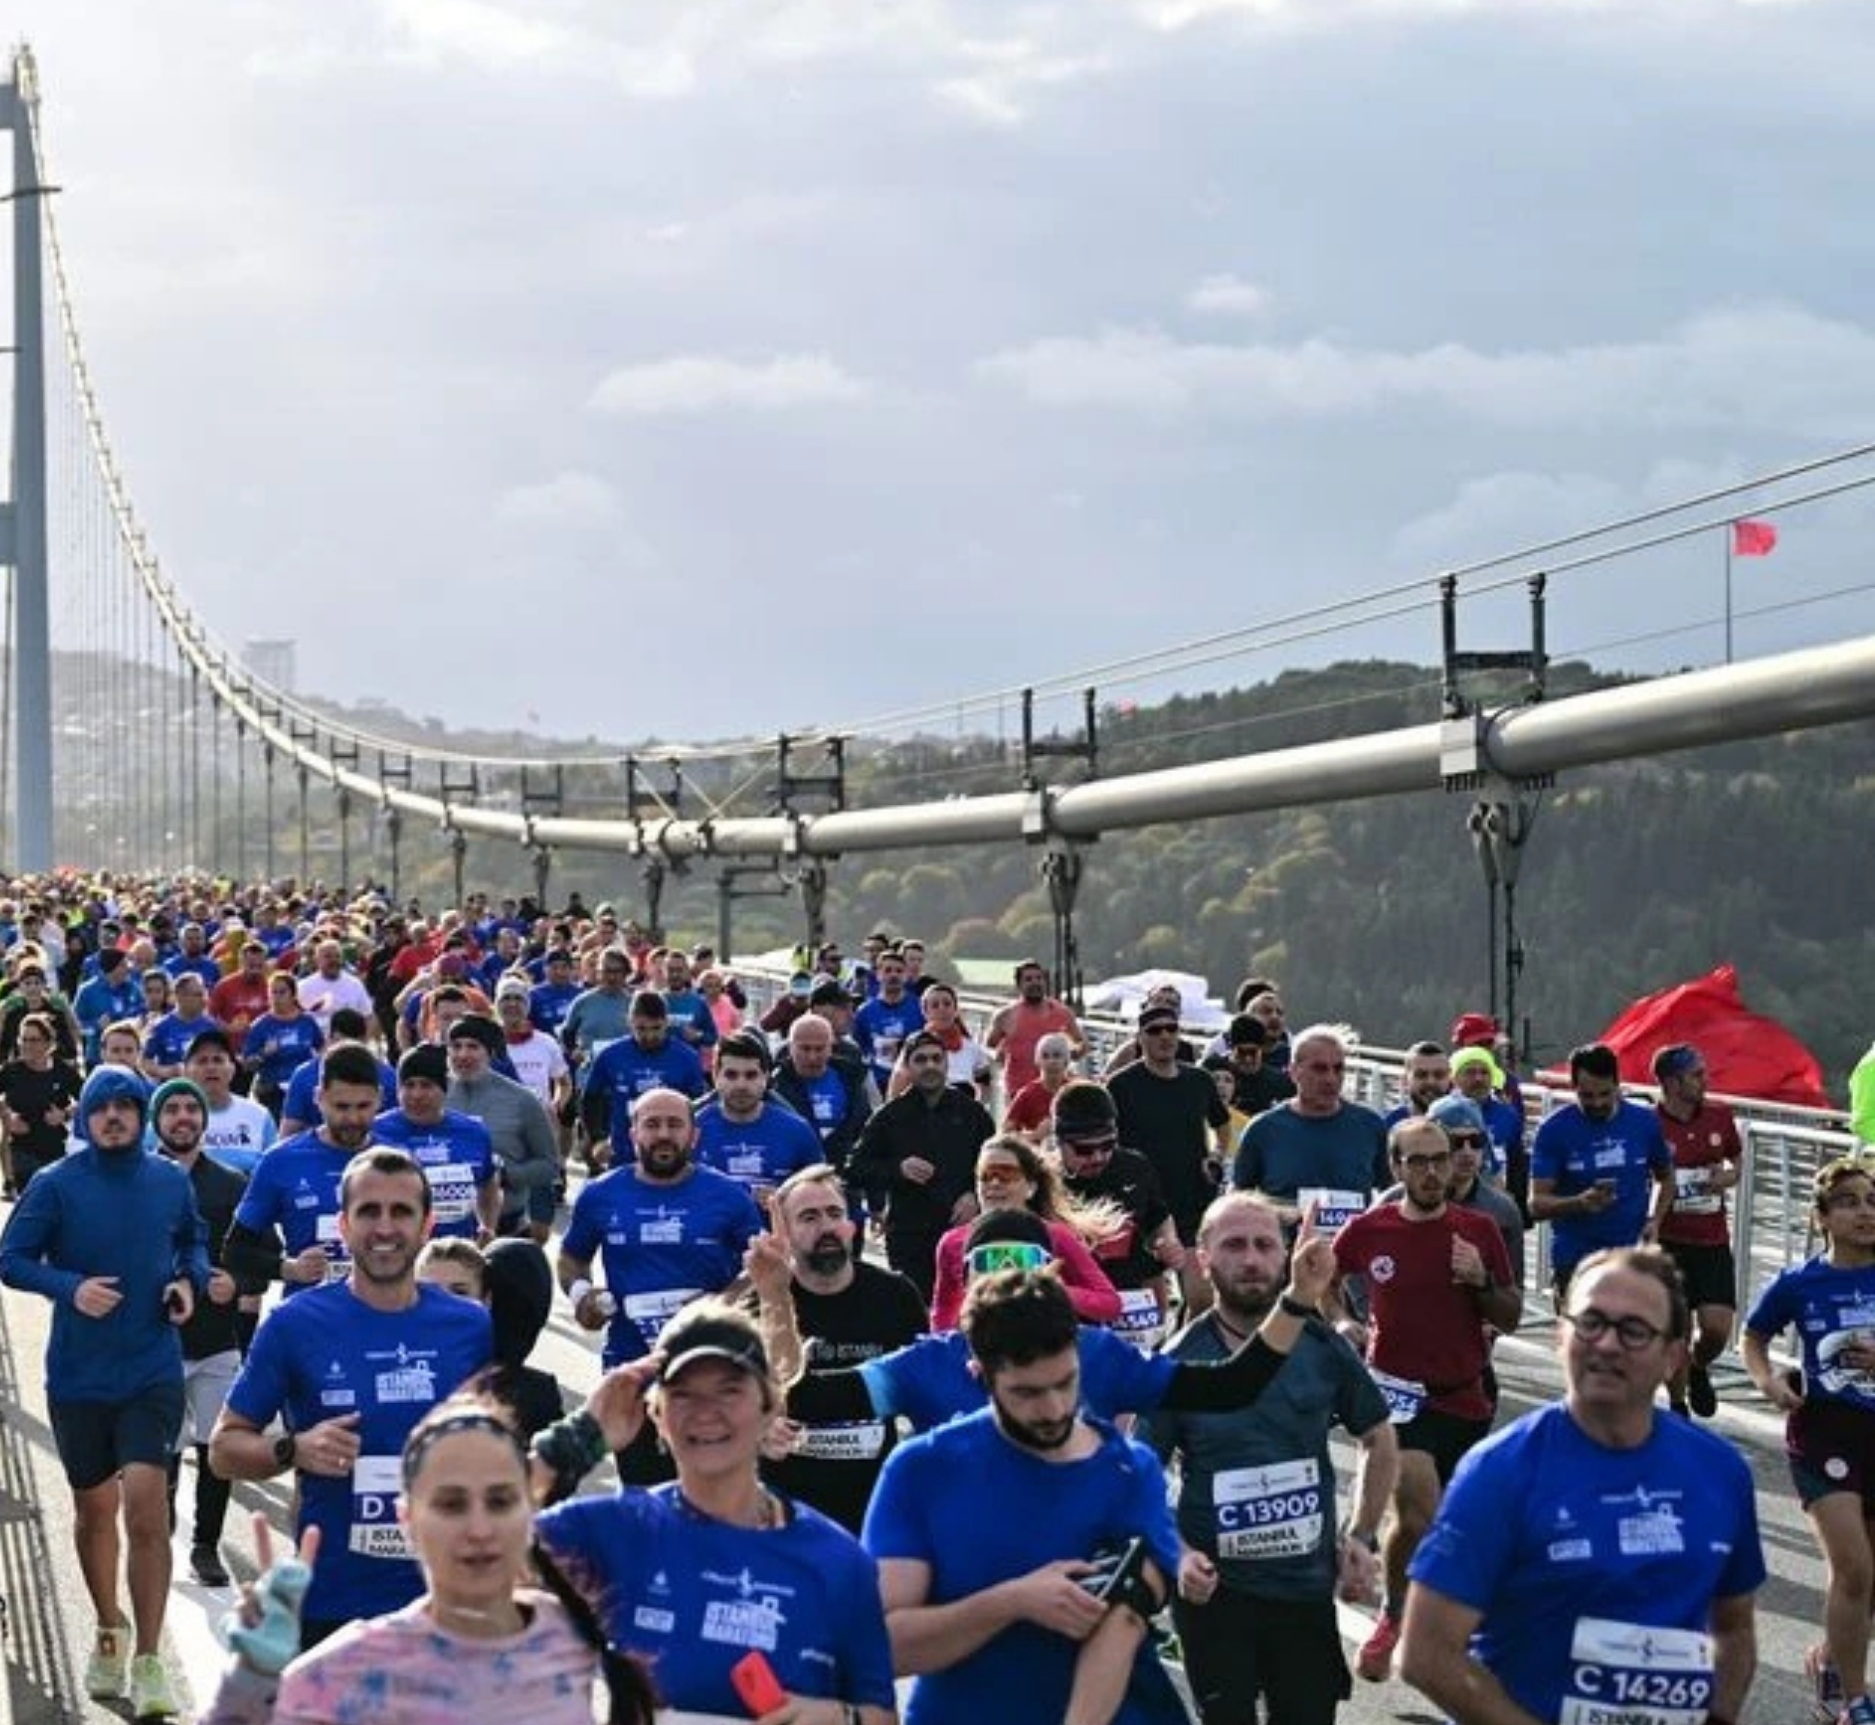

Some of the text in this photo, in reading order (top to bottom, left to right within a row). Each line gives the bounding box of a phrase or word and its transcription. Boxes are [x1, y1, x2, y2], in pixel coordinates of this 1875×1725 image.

[362, 1495, 385, 1520] D
[1218, 1490, 1320, 1527] C 13909
[371, 1529, 405, 1542] ISTA
[1574, 1663, 1710, 1707] C 14269
